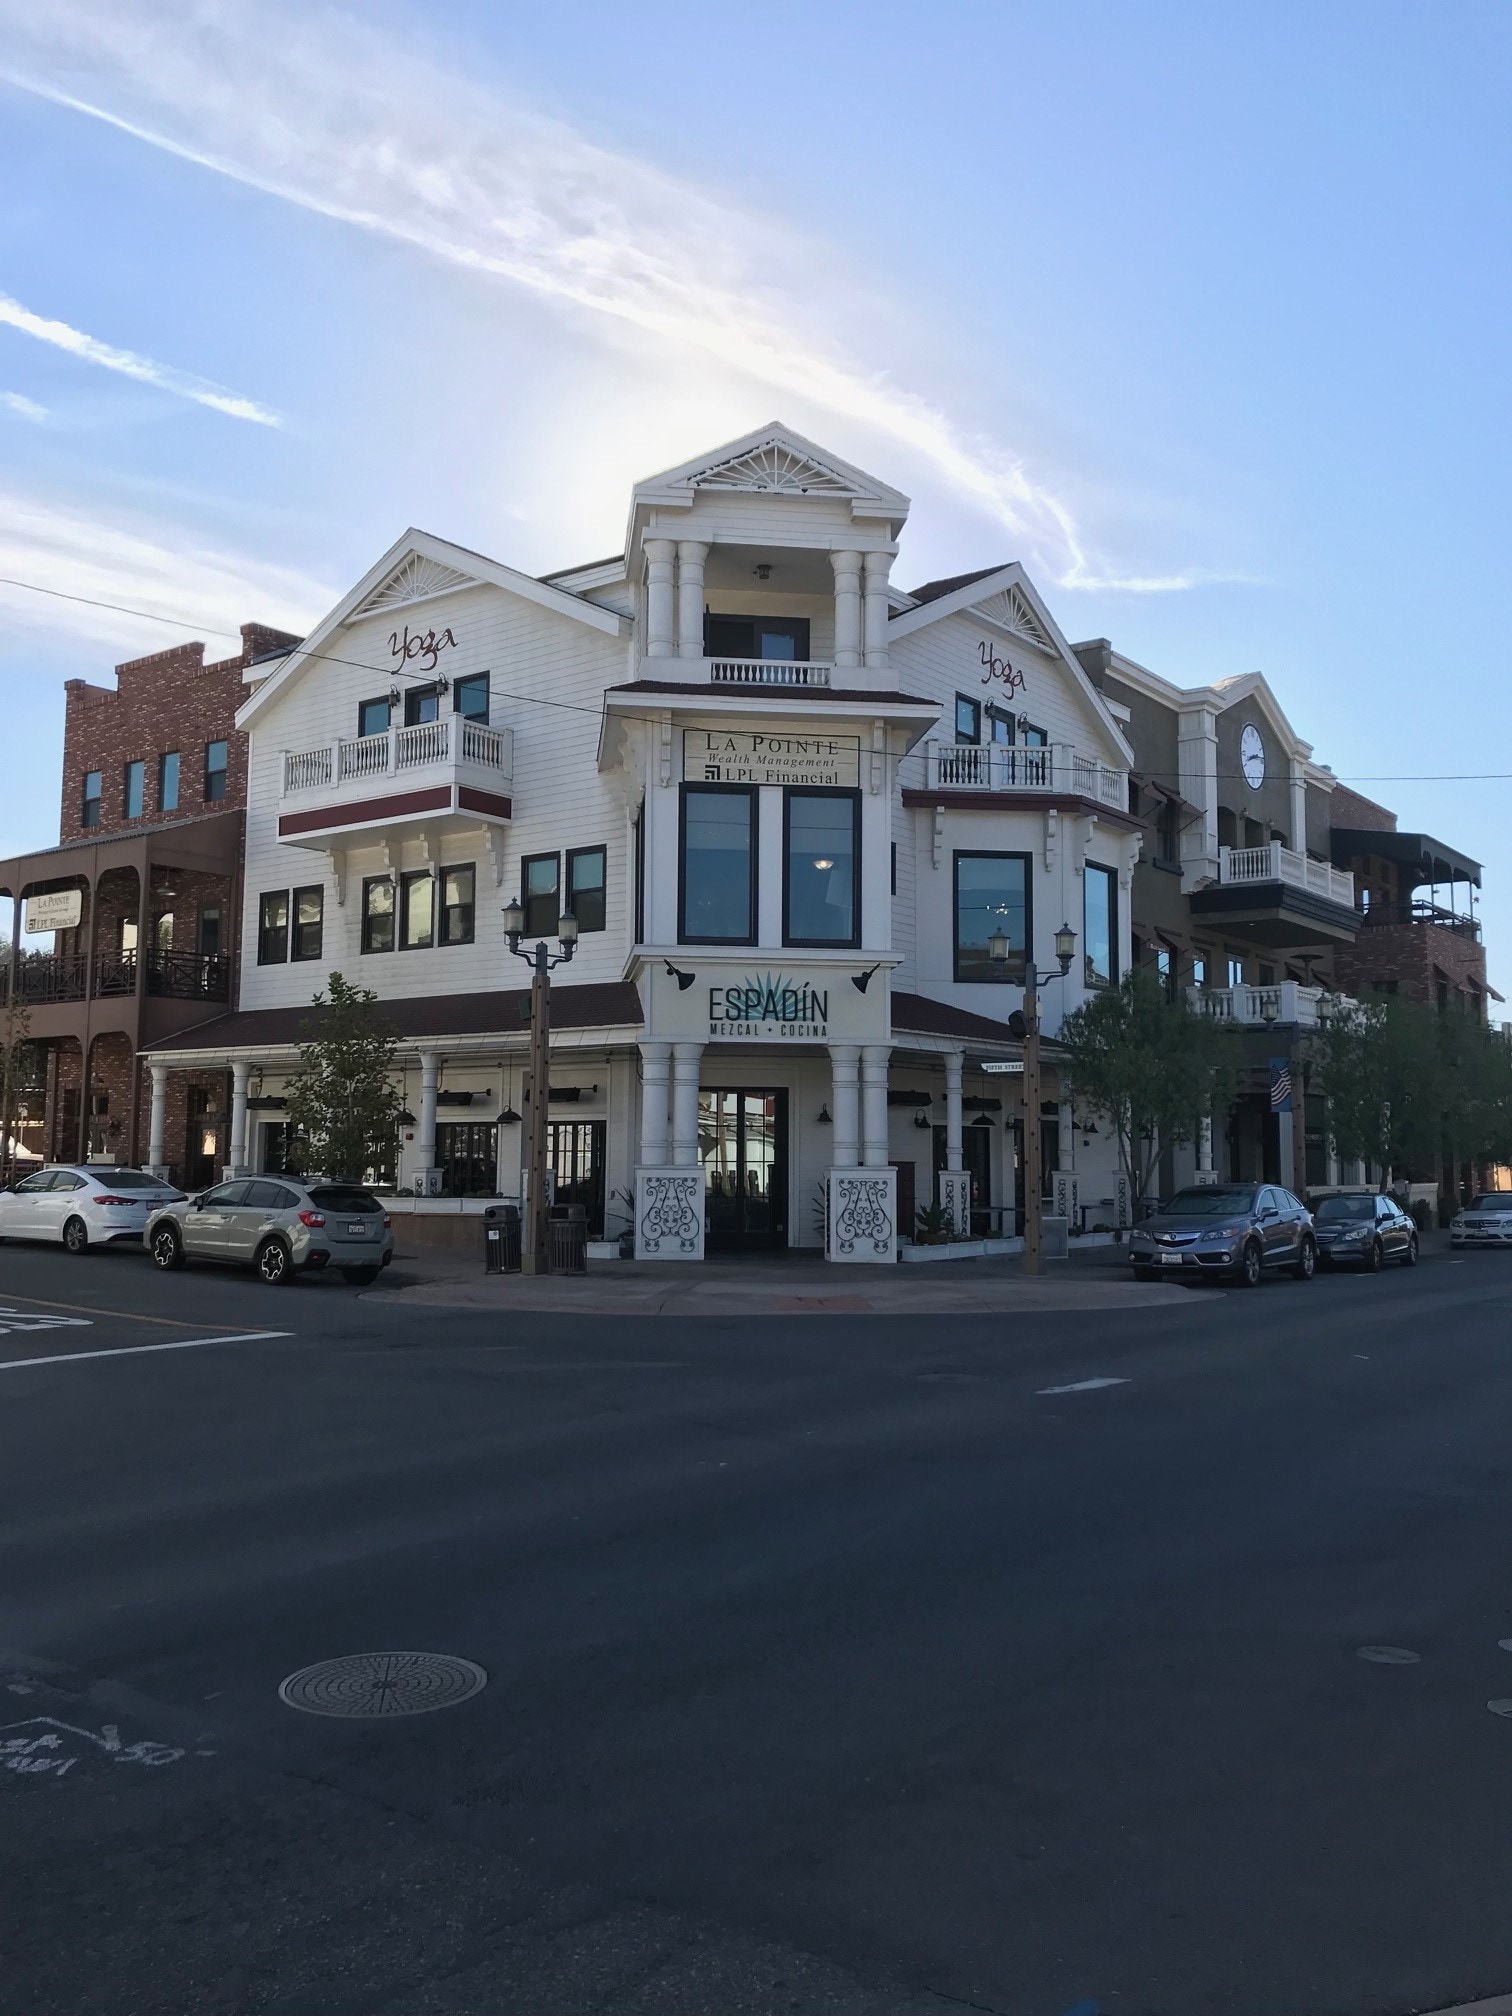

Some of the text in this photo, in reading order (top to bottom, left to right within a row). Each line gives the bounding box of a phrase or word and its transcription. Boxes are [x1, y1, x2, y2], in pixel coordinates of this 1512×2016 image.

[387, 625, 459, 675] Yoga
[977, 640, 1027, 701] Yoga
[752, 735, 839, 755] POINTE
[708, 753, 835, 768] Wealth Management
[726, 768, 839, 785] LPL Financial
[709, 981, 828, 1022] ESPADÍN
[710, 1023, 759, 1036] MEZCAL
[781, 1024, 827, 1037] COCINA
